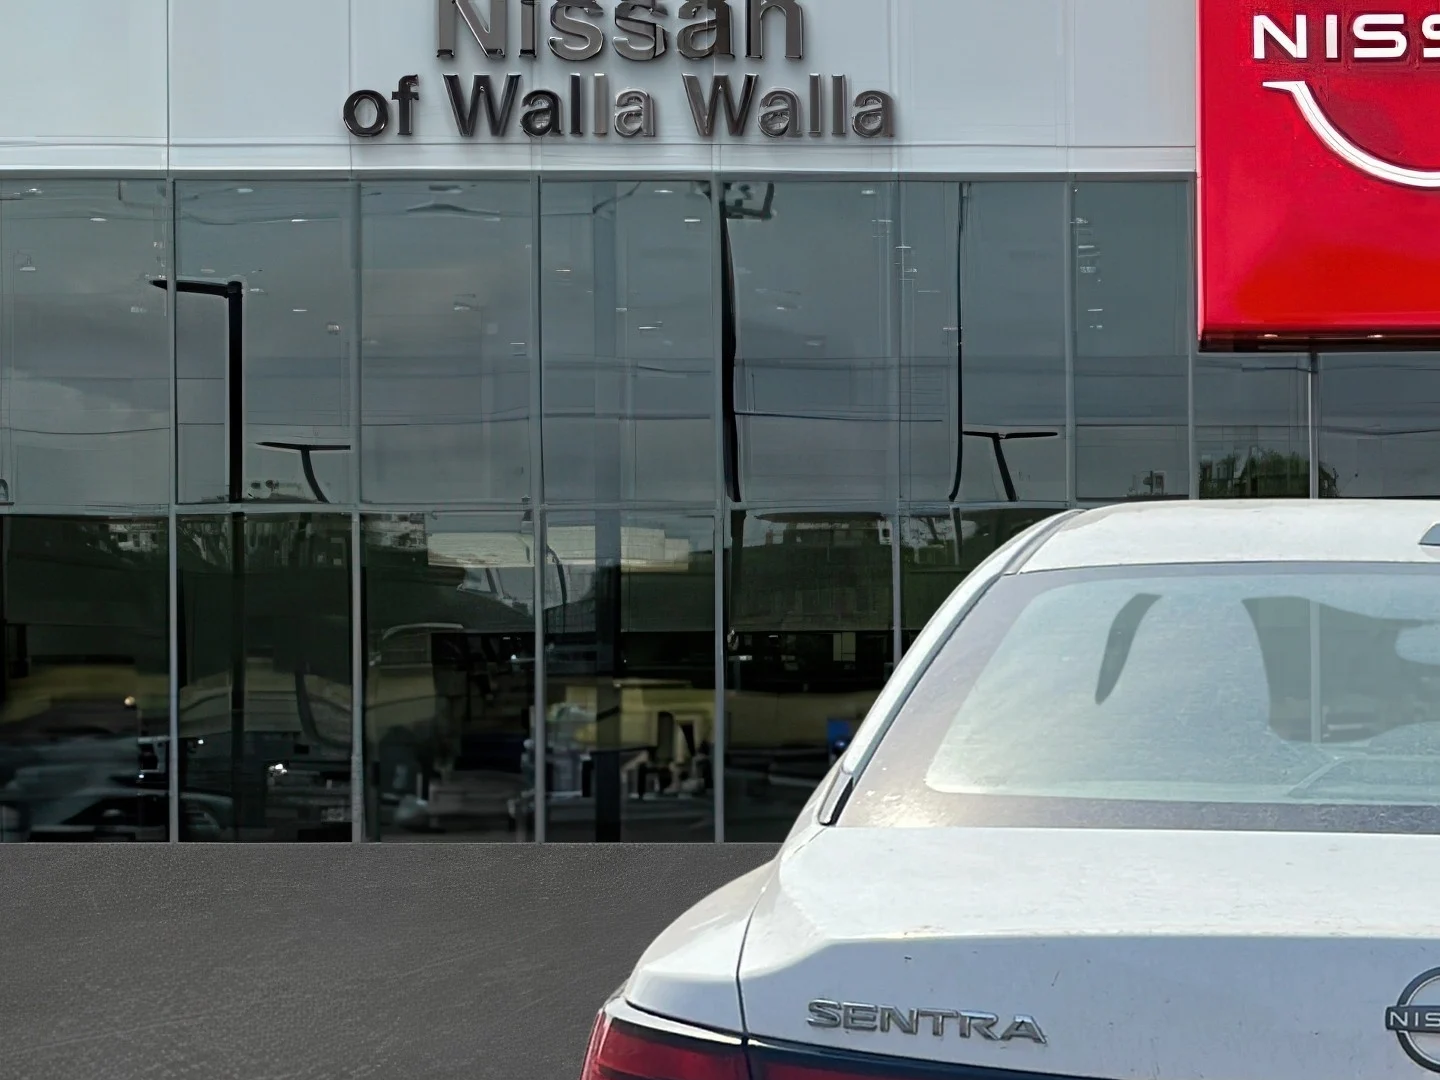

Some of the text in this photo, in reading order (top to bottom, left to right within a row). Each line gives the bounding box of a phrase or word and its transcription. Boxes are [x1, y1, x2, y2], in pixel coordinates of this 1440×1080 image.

[342, 72, 894, 138] of Walla Walla
[806, 998, 1048, 1045] SENTRA
